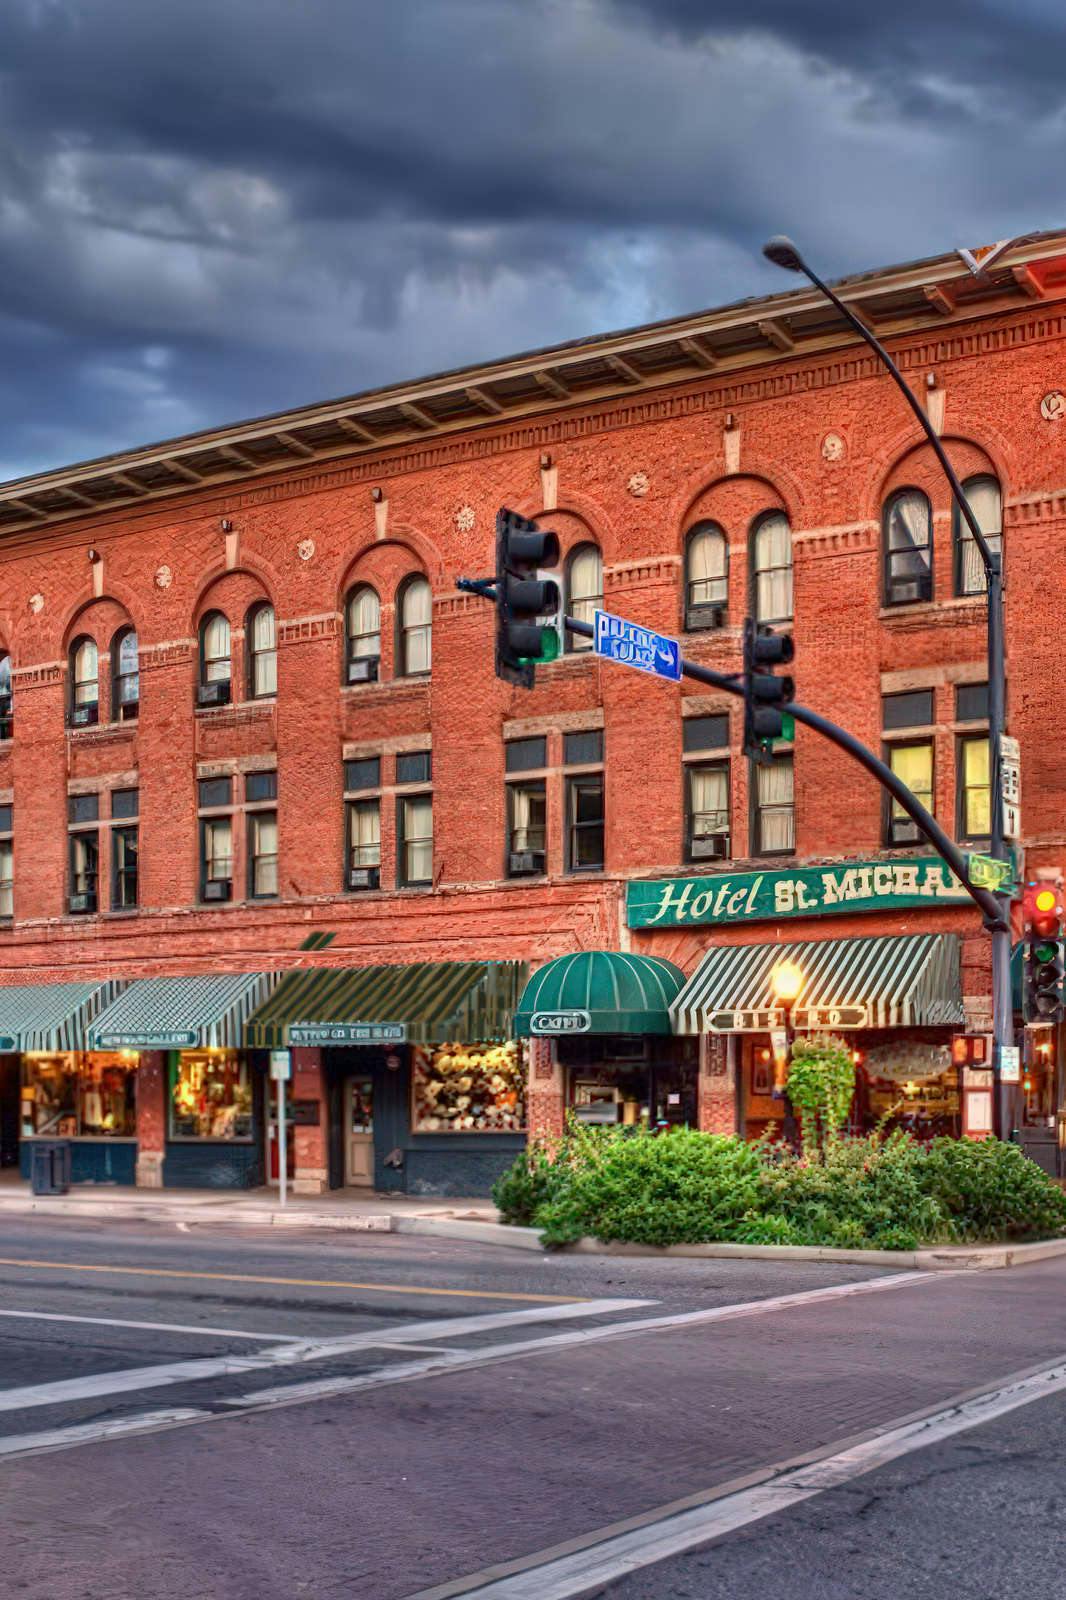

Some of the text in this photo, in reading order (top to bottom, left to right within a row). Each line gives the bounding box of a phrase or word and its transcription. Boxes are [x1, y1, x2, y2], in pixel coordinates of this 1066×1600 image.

[648, 875, 764, 924] Hotel
[775, 879, 818, 913] St.
[822, 865, 972, 905] MICHA
